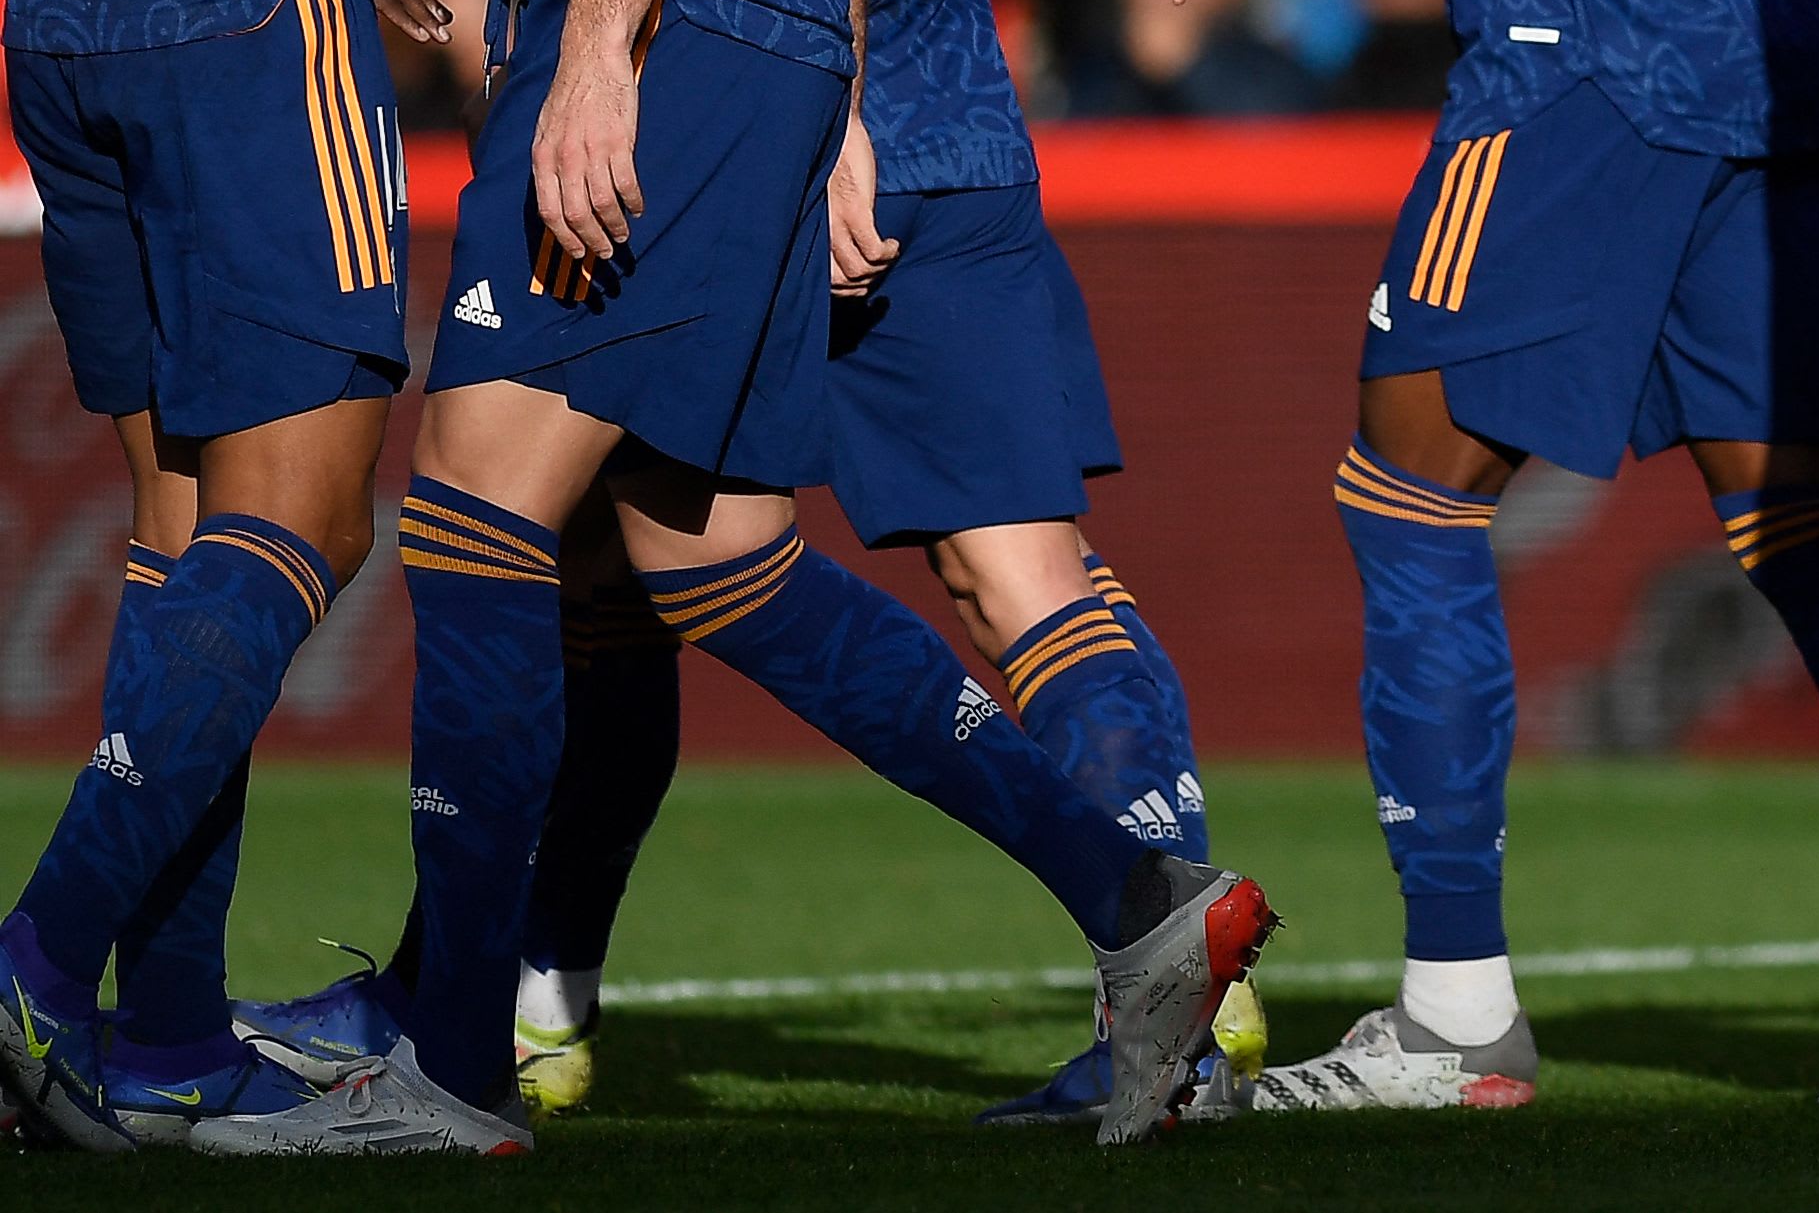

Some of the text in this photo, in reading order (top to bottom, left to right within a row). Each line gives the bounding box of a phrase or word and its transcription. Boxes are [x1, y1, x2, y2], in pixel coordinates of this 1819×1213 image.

[454, 304, 502, 329] adidas
[955, 699, 1003, 741] adida
[410, 787, 445, 801] EAL
